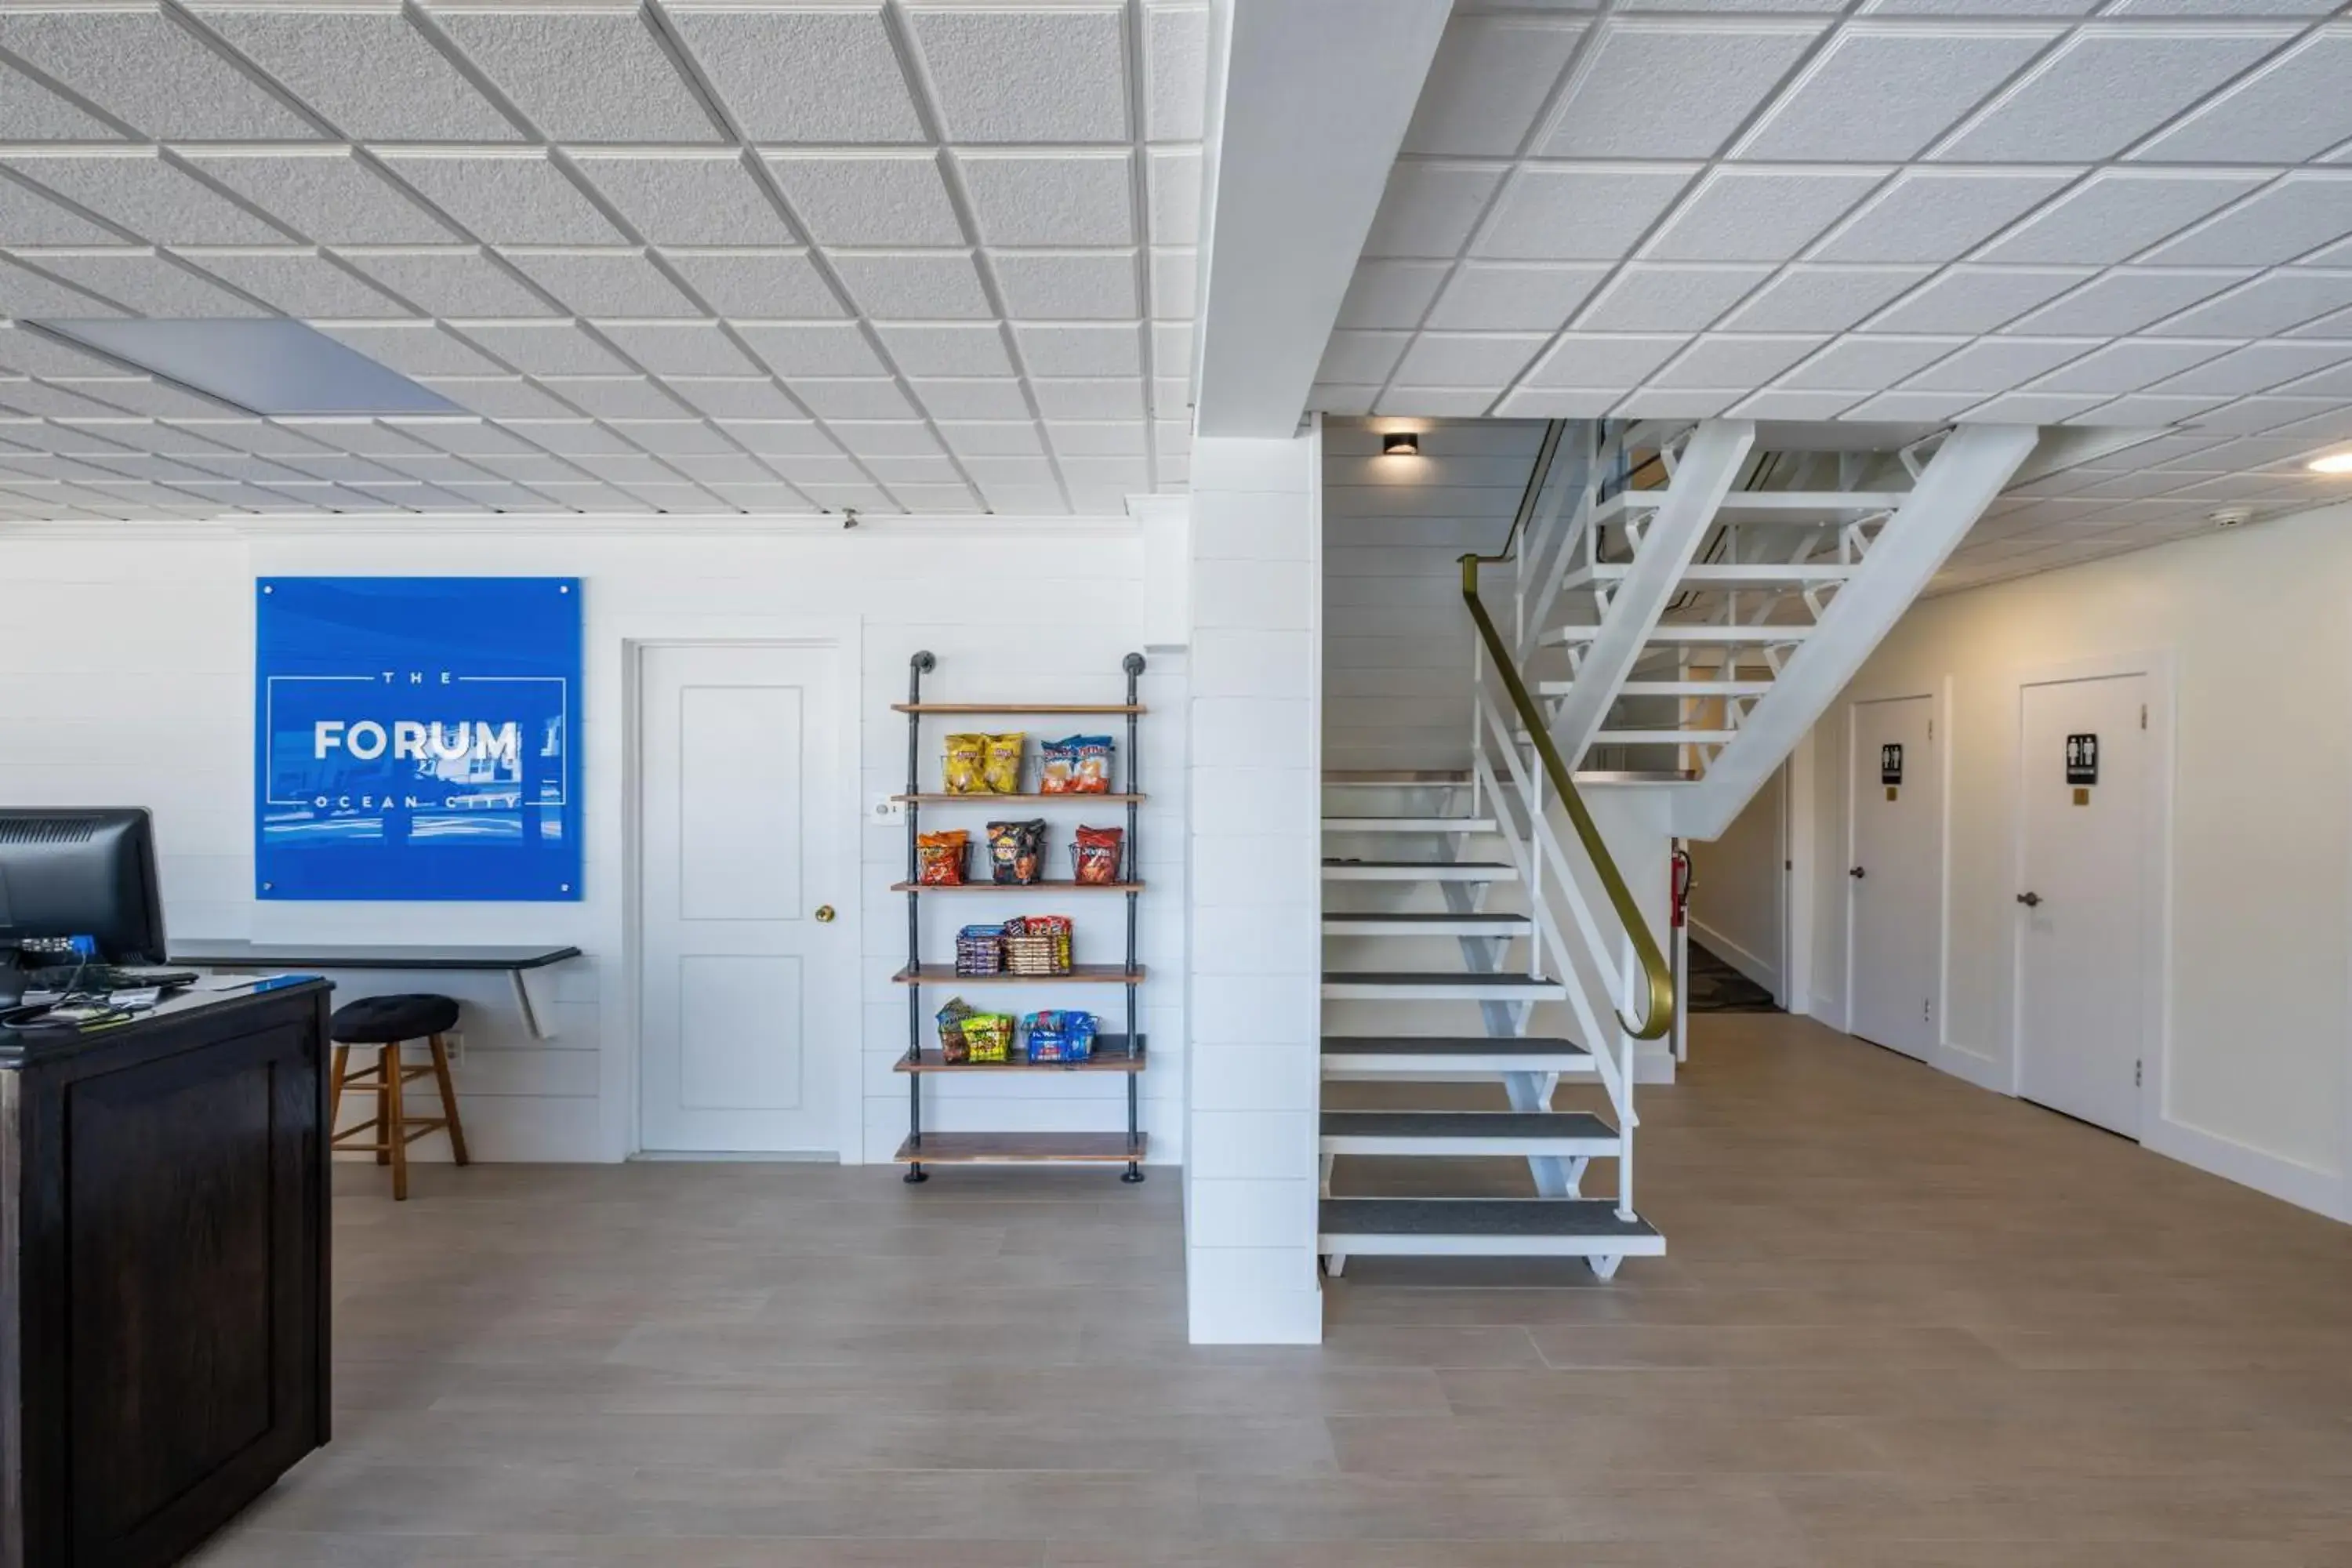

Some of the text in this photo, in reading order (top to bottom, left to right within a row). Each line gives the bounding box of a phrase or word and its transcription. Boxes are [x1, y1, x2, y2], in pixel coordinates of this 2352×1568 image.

[383, 672, 451, 684] THE
[314, 720, 517, 760] FORUM
[315, 796, 515, 808] OCEAN CITY
